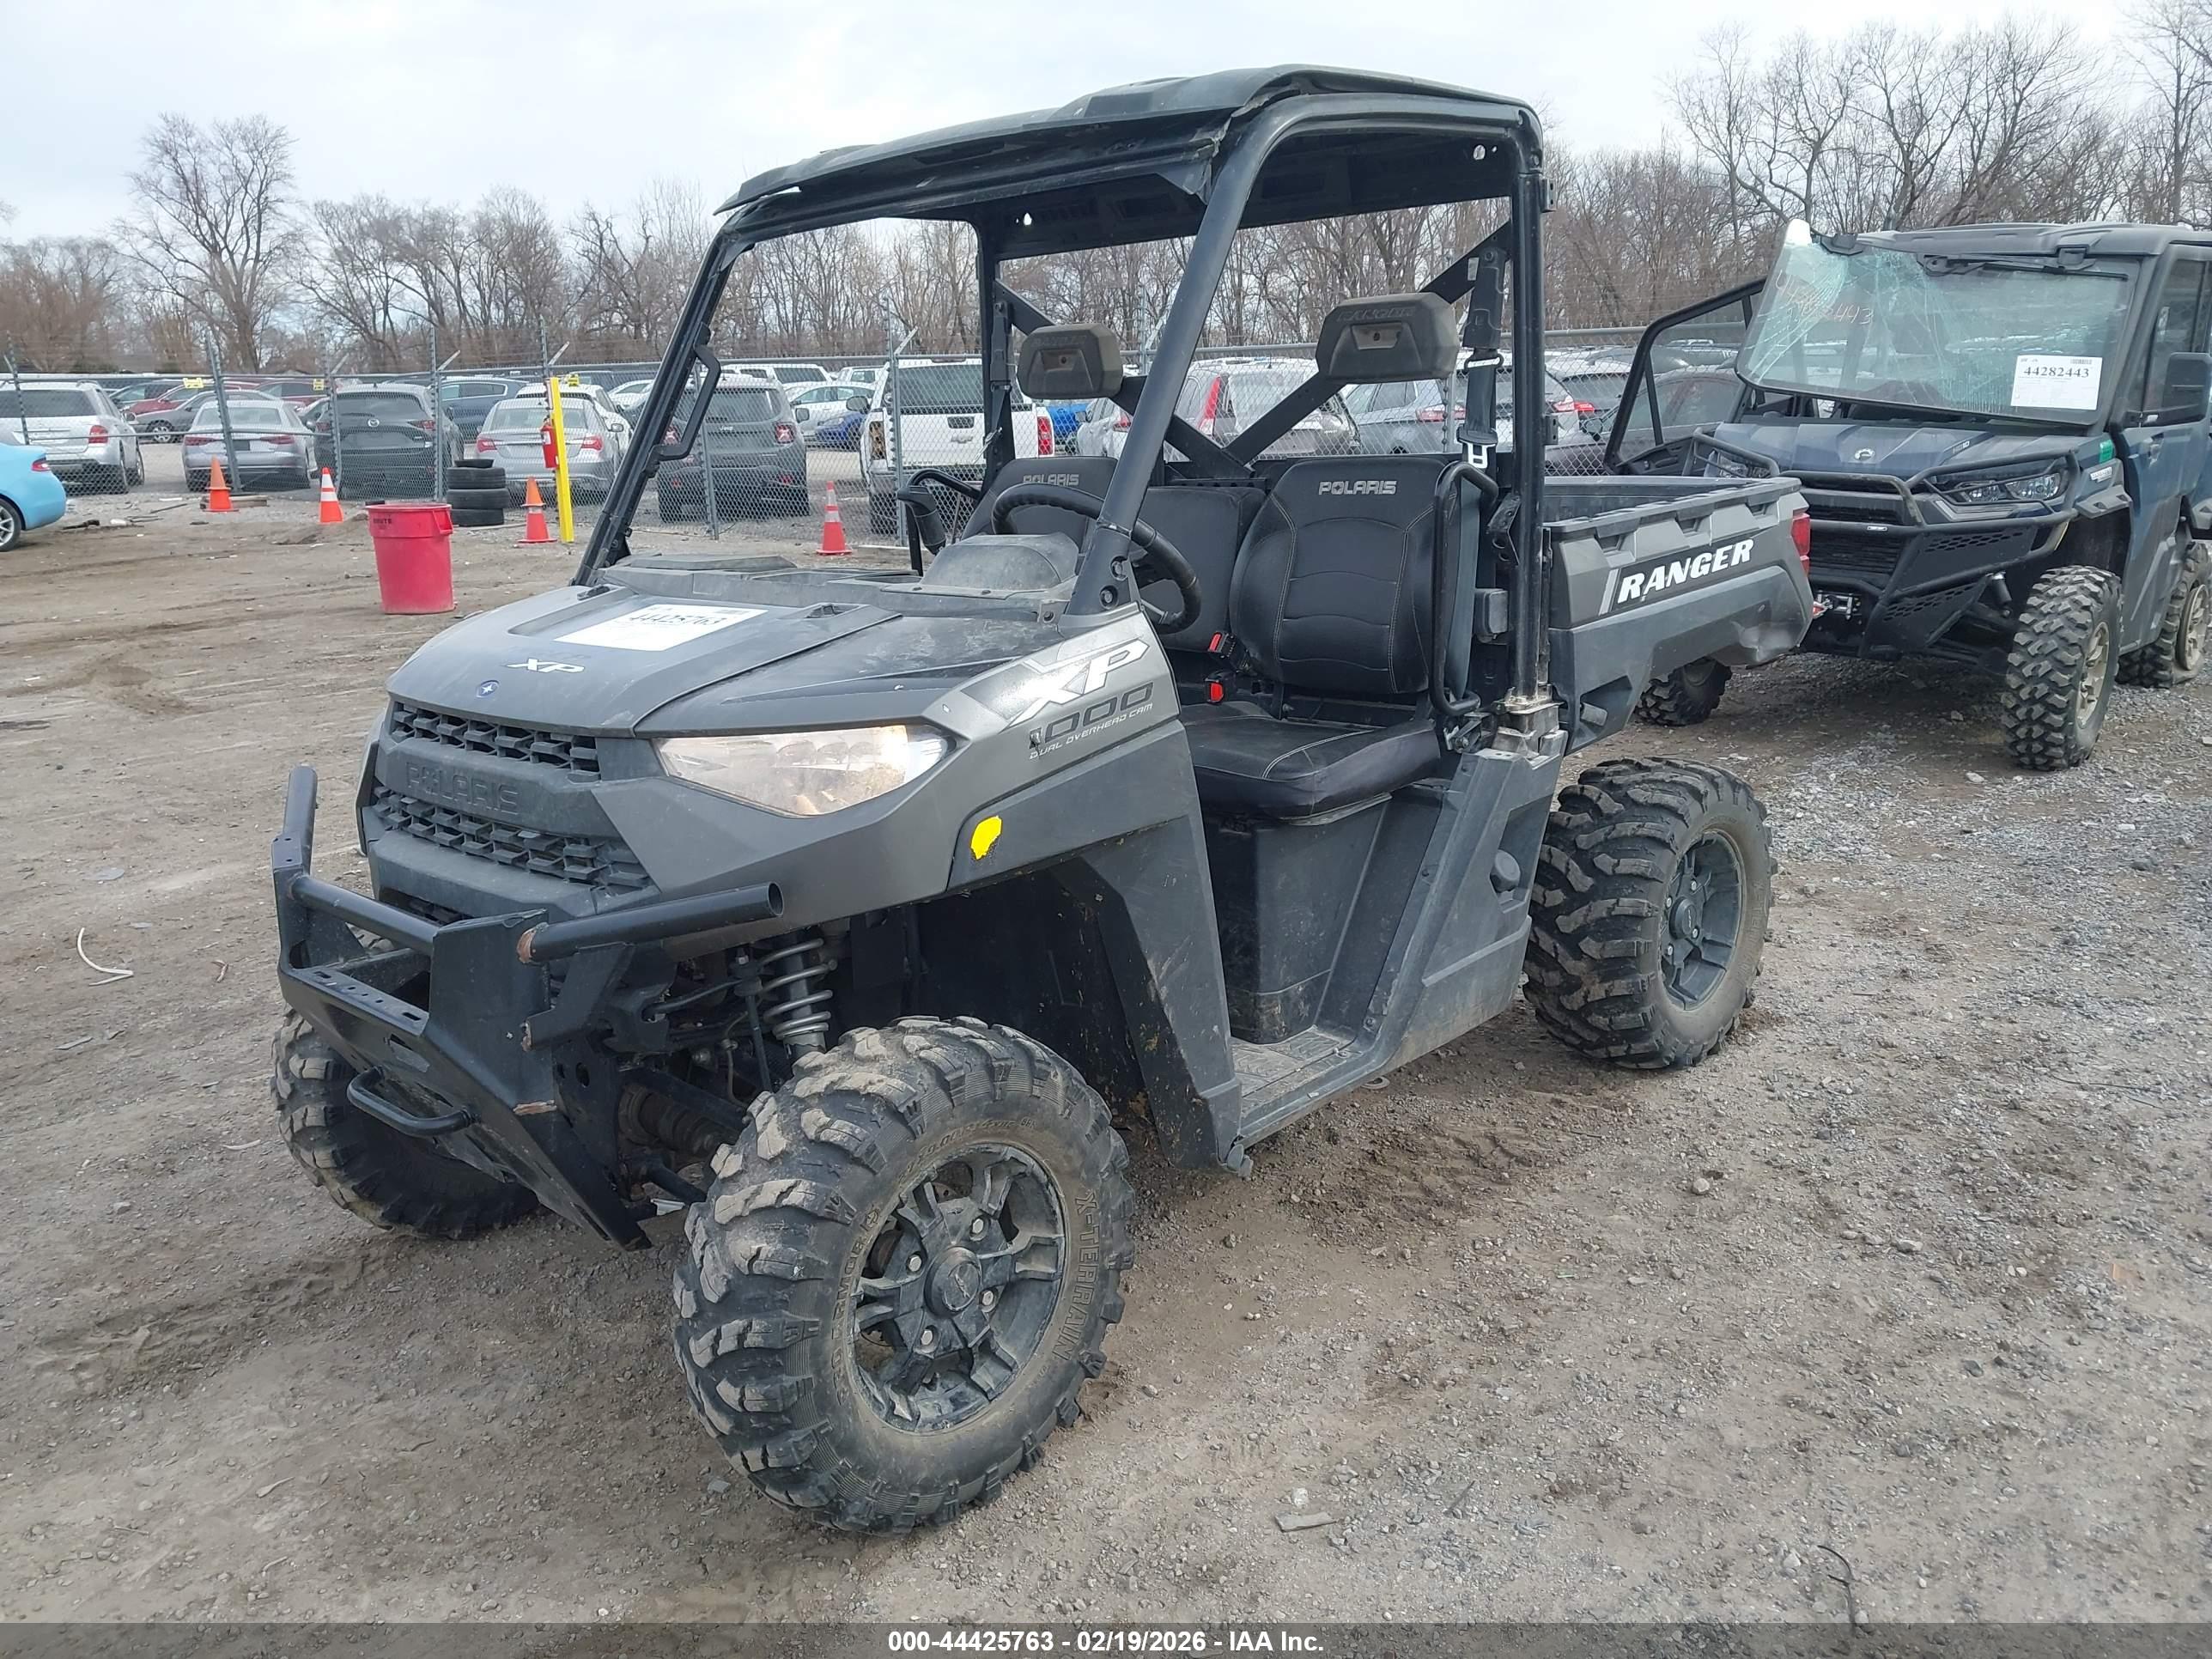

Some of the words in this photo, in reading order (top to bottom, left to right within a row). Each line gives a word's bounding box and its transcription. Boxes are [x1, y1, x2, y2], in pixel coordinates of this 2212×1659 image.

[2023, 366, 2089, 378] 44282443
[1024, 473, 1079, 487] POLARIS
[1318, 480, 1397, 495] POLARIS
[1617, 538, 1754, 604] RANGER
[505, 658, 586, 673] XP
[1000, 638, 1151, 734] XP
[1030, 681, 1154, 750] 1000
[1030, 742, 1063, 760] DUAL
[1066, 714, 1127, 744] OVERHEAD
[1129, 702, 1153, 718] CAM
[405, 761, 520, 815] POLARIS
[831, 1235, 872, 1340] ARMOR
[1052, 1192, 1100, 1362] X-TERRAIN
